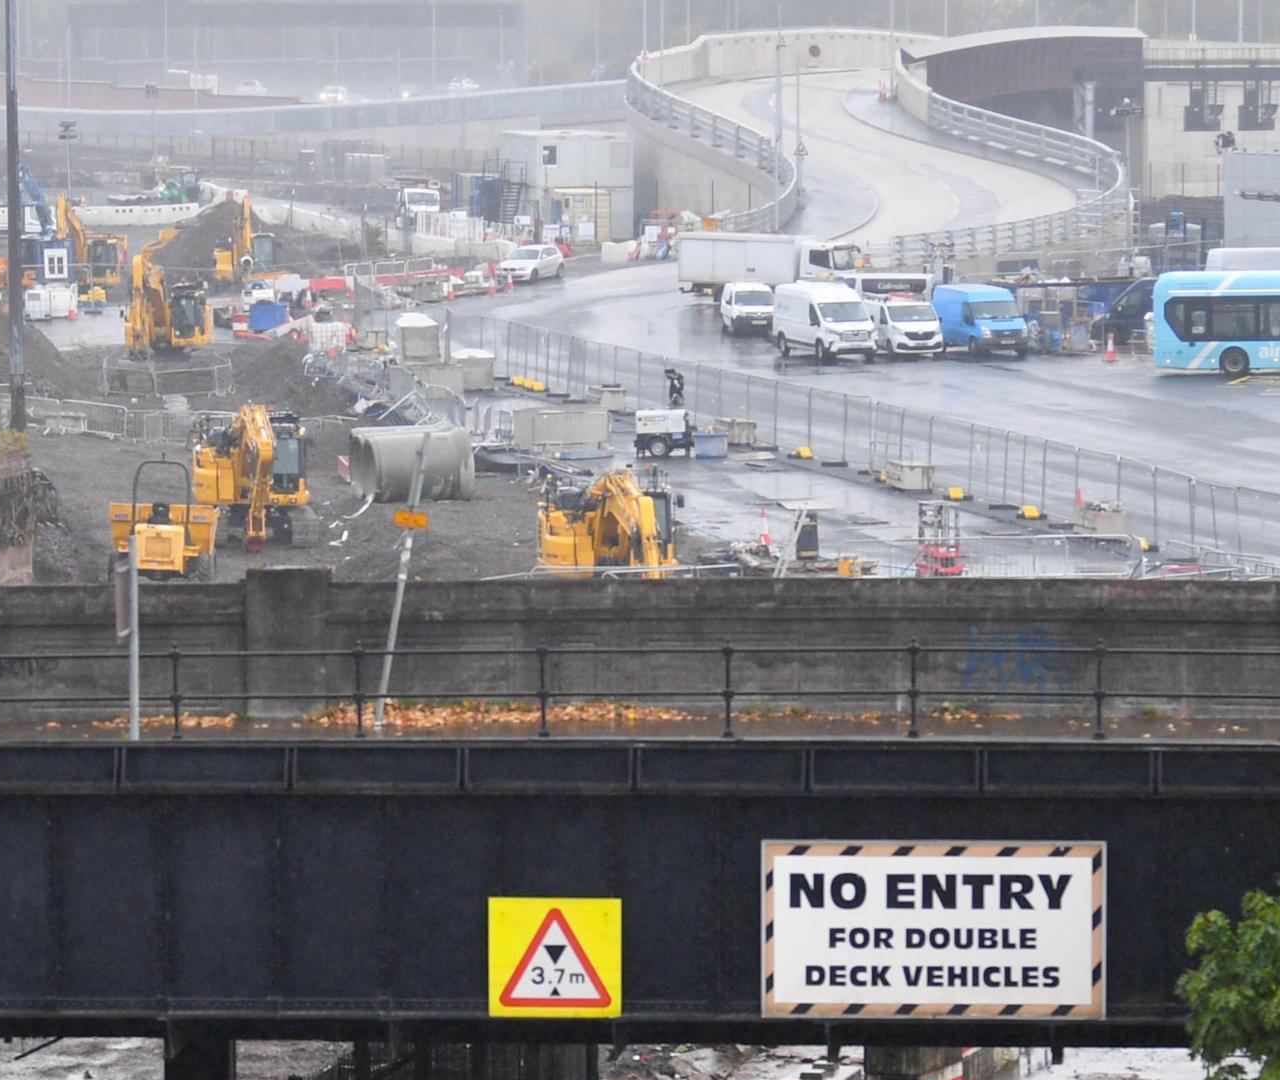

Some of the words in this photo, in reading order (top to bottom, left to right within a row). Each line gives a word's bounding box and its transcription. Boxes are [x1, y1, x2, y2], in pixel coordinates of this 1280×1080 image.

[789, 873, 867, 909] NO
[886, 874, 1073, 910] ENTRY
[828, 927, 894, 949] FOR
[905, 928, 1038, 949] DOUBLE
[805, 965, 892, 987] DECK
[902, 966, 1060, 988] VEHICLES
